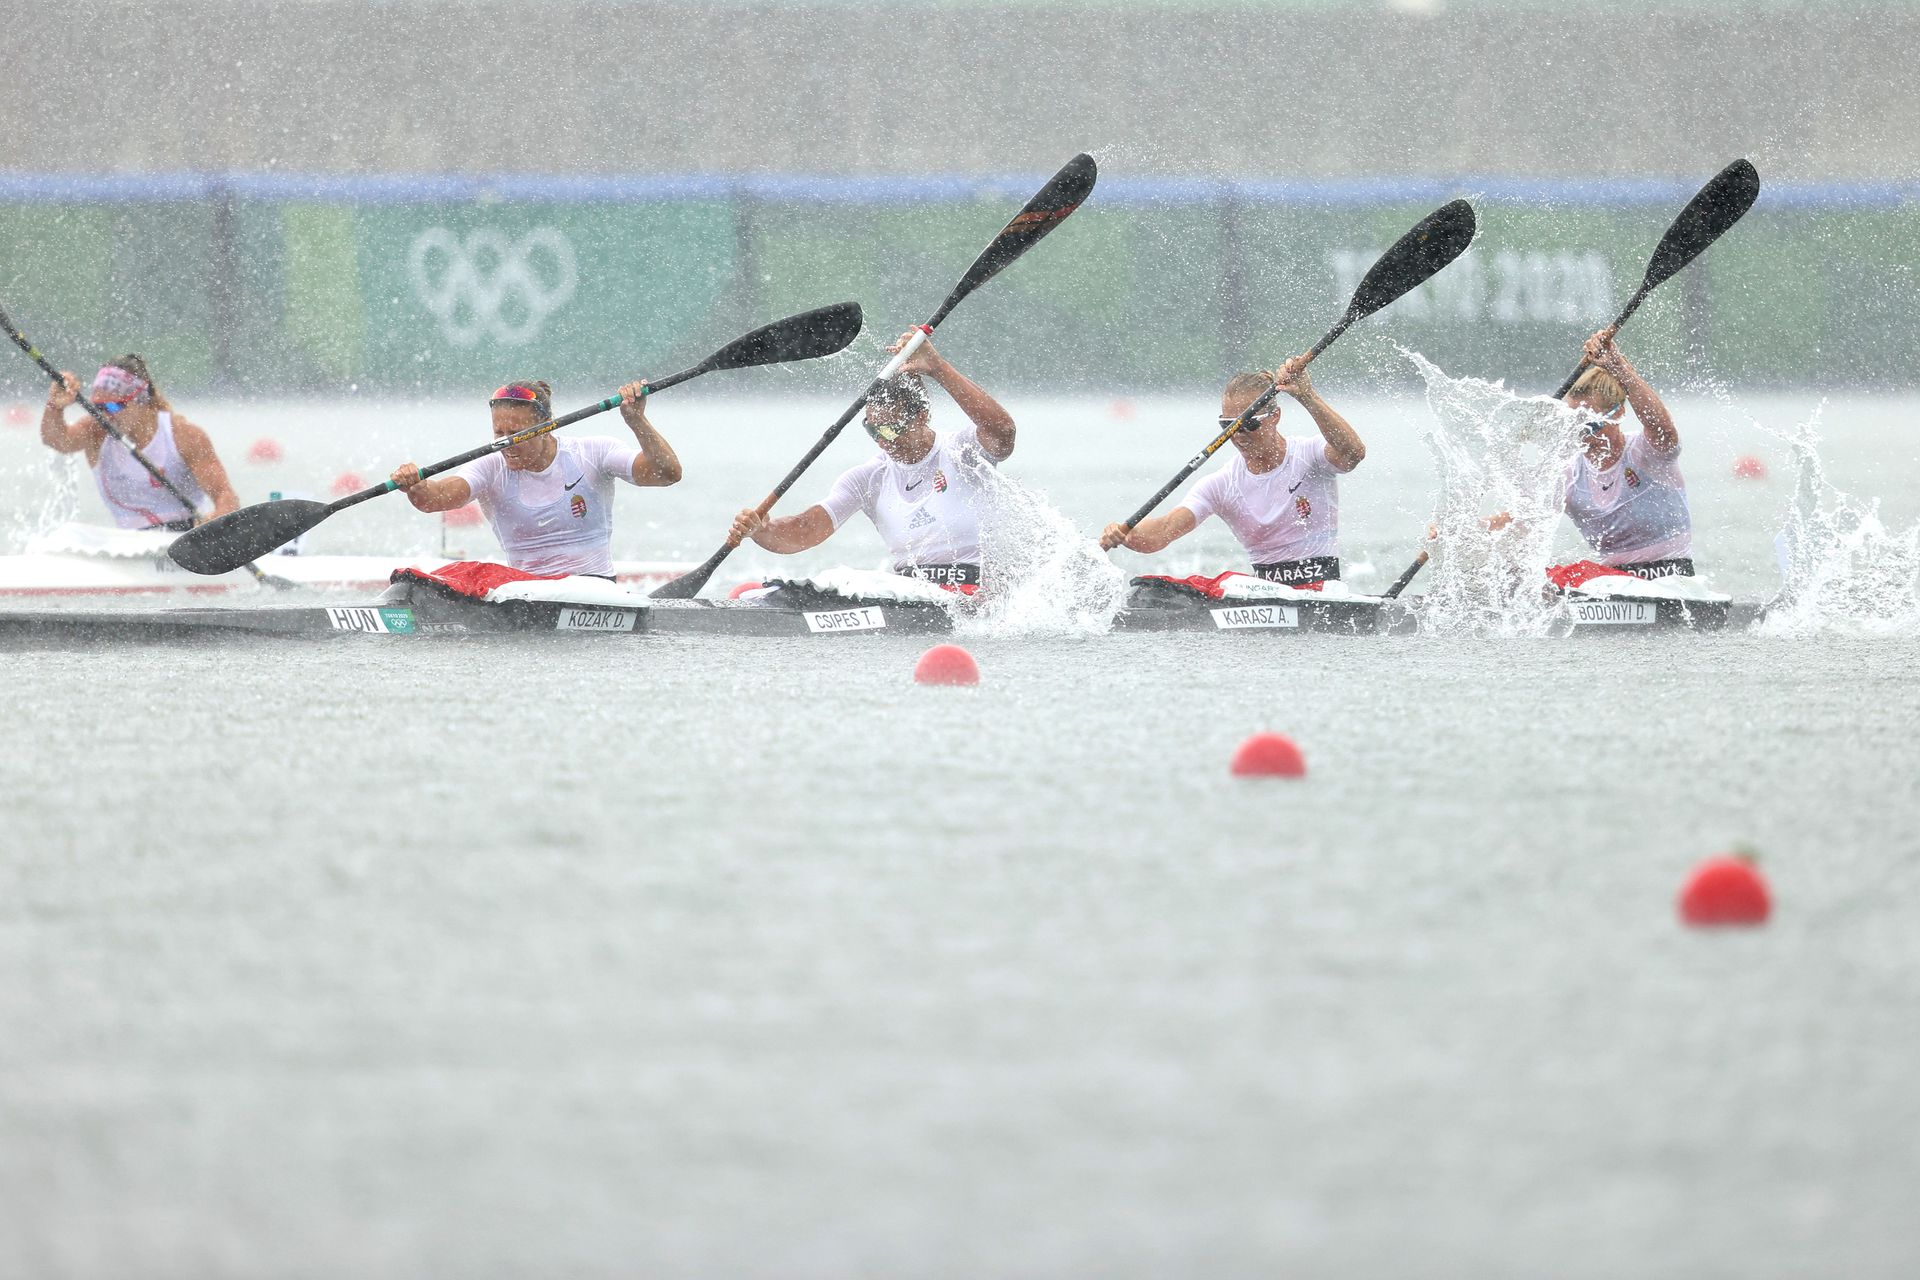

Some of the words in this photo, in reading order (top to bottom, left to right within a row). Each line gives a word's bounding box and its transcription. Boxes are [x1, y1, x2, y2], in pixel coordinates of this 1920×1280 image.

[332, 608, 380, 632] HUN
[568, 610, 612, 627] KOZAK
[613, 612, 626, 628] D.
[814, 611, 861, 629] CSIPES
[860, 609, 877, 626] T.
[1222, 607, 1275, 626] KARASZ
[1277, 607, 1291, 625] A.
[1578, 603, 1632, 621] BODONYI
[1636, 603, 1648, 621] D.
